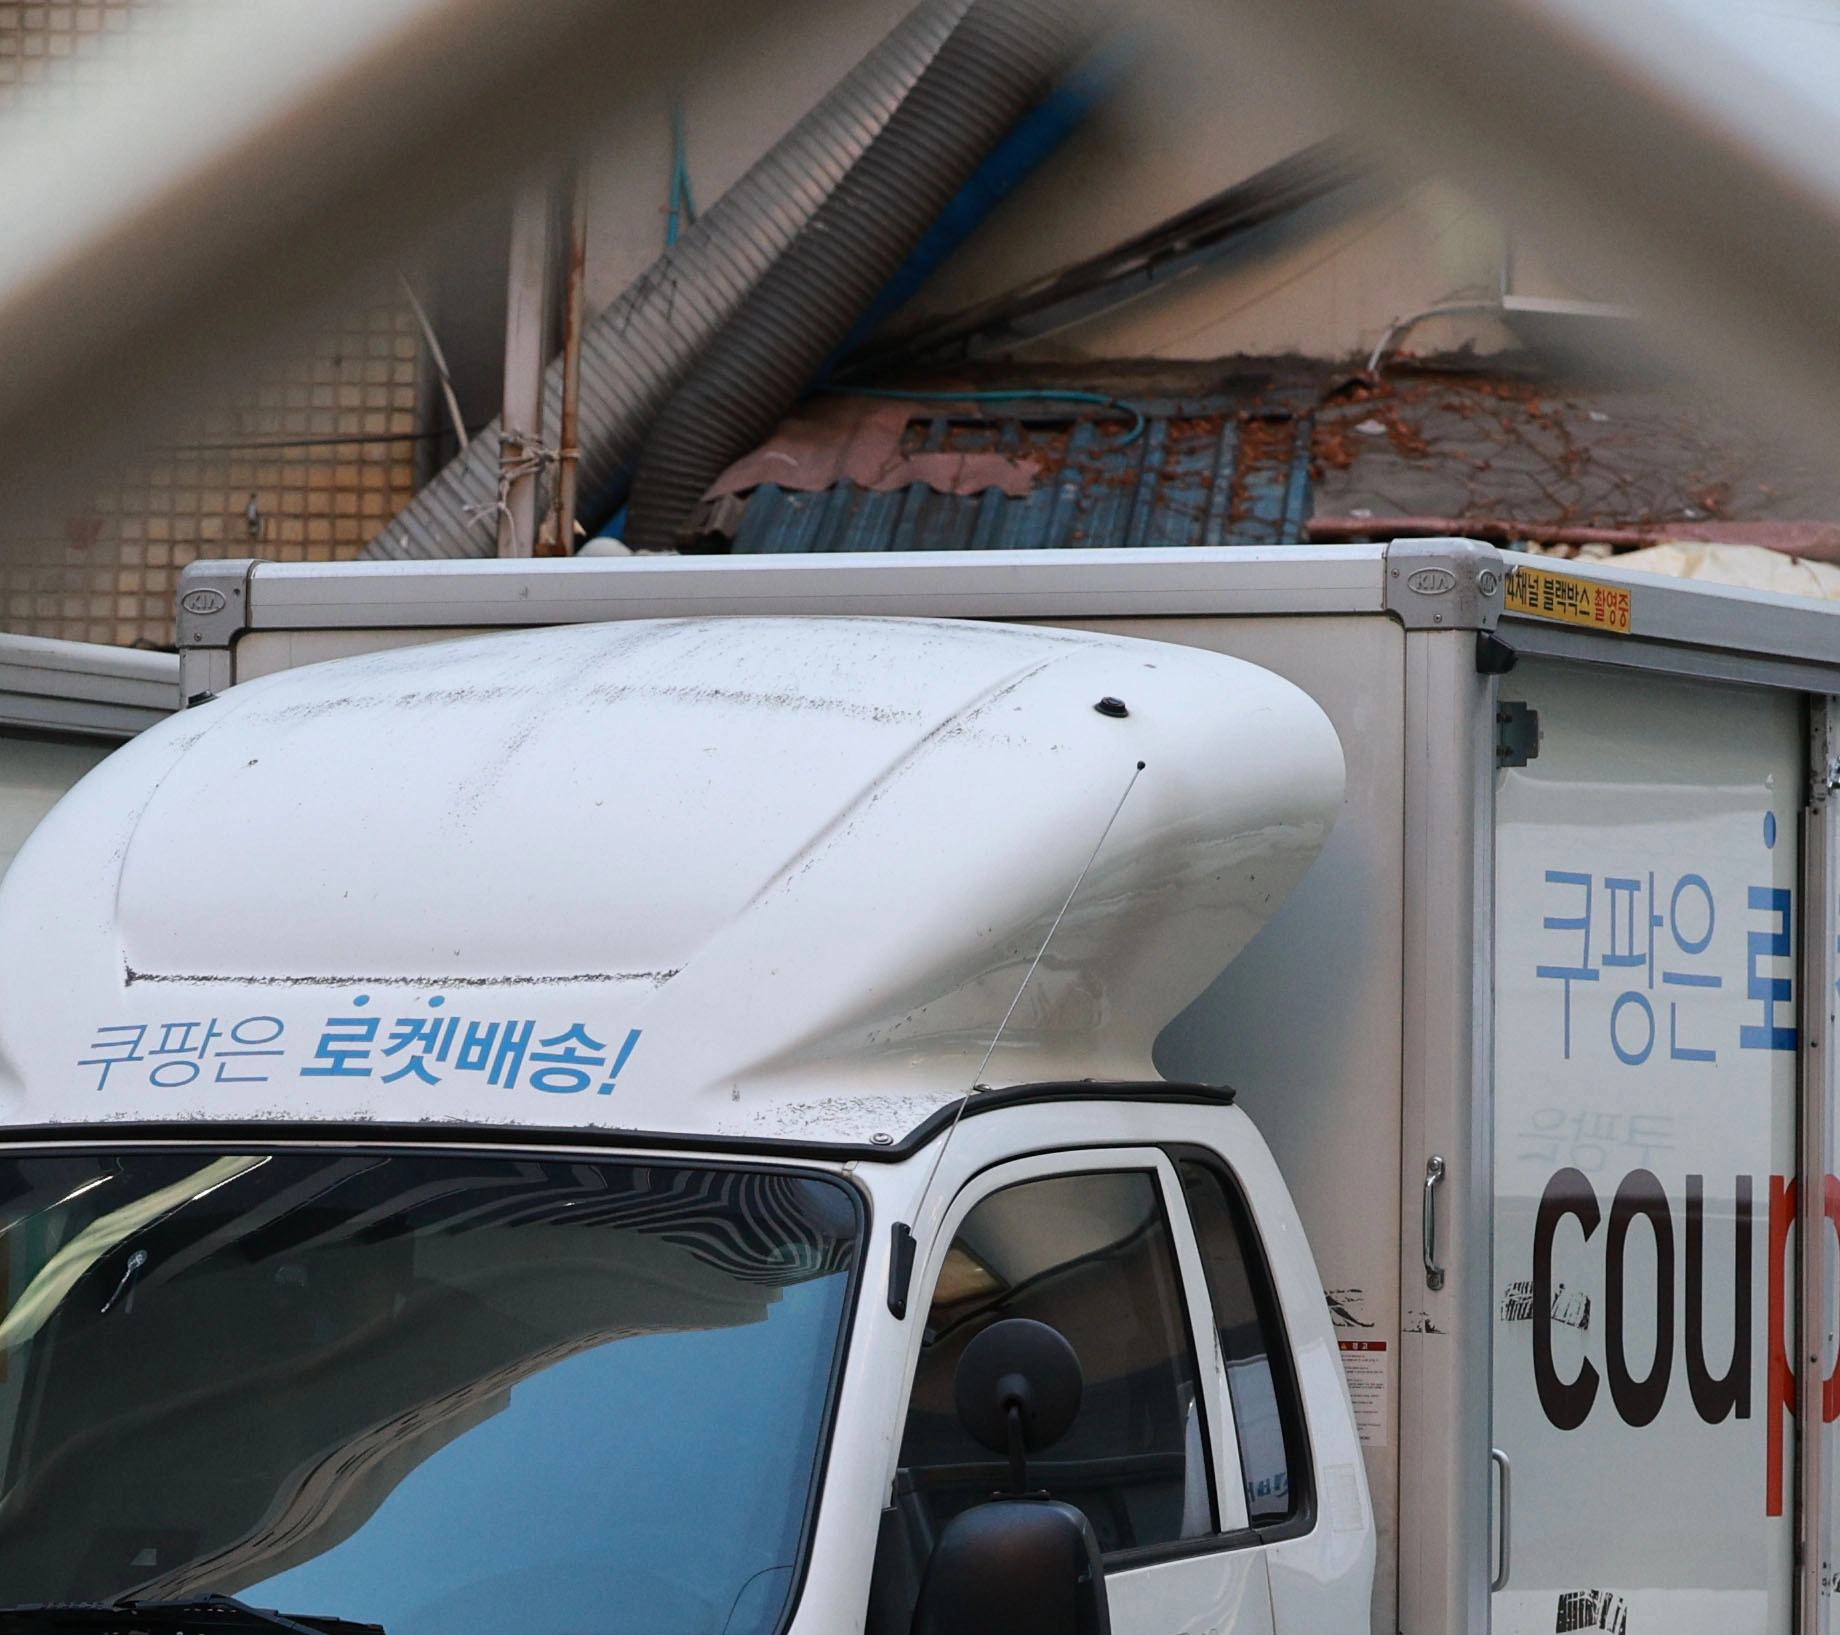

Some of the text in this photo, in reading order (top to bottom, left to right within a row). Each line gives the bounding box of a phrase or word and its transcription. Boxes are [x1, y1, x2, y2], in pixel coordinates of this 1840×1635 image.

[1416, 572, 1449, 591] KIA
[1543, 577, 1590, 617] 블랙박스
[1595, 588, 1629, 627] 촬영중
[1536, 870, 1722, 1065] 쿠팡은
[76, 1010, 642, 1097] 쿠팡은 로켓배송!
